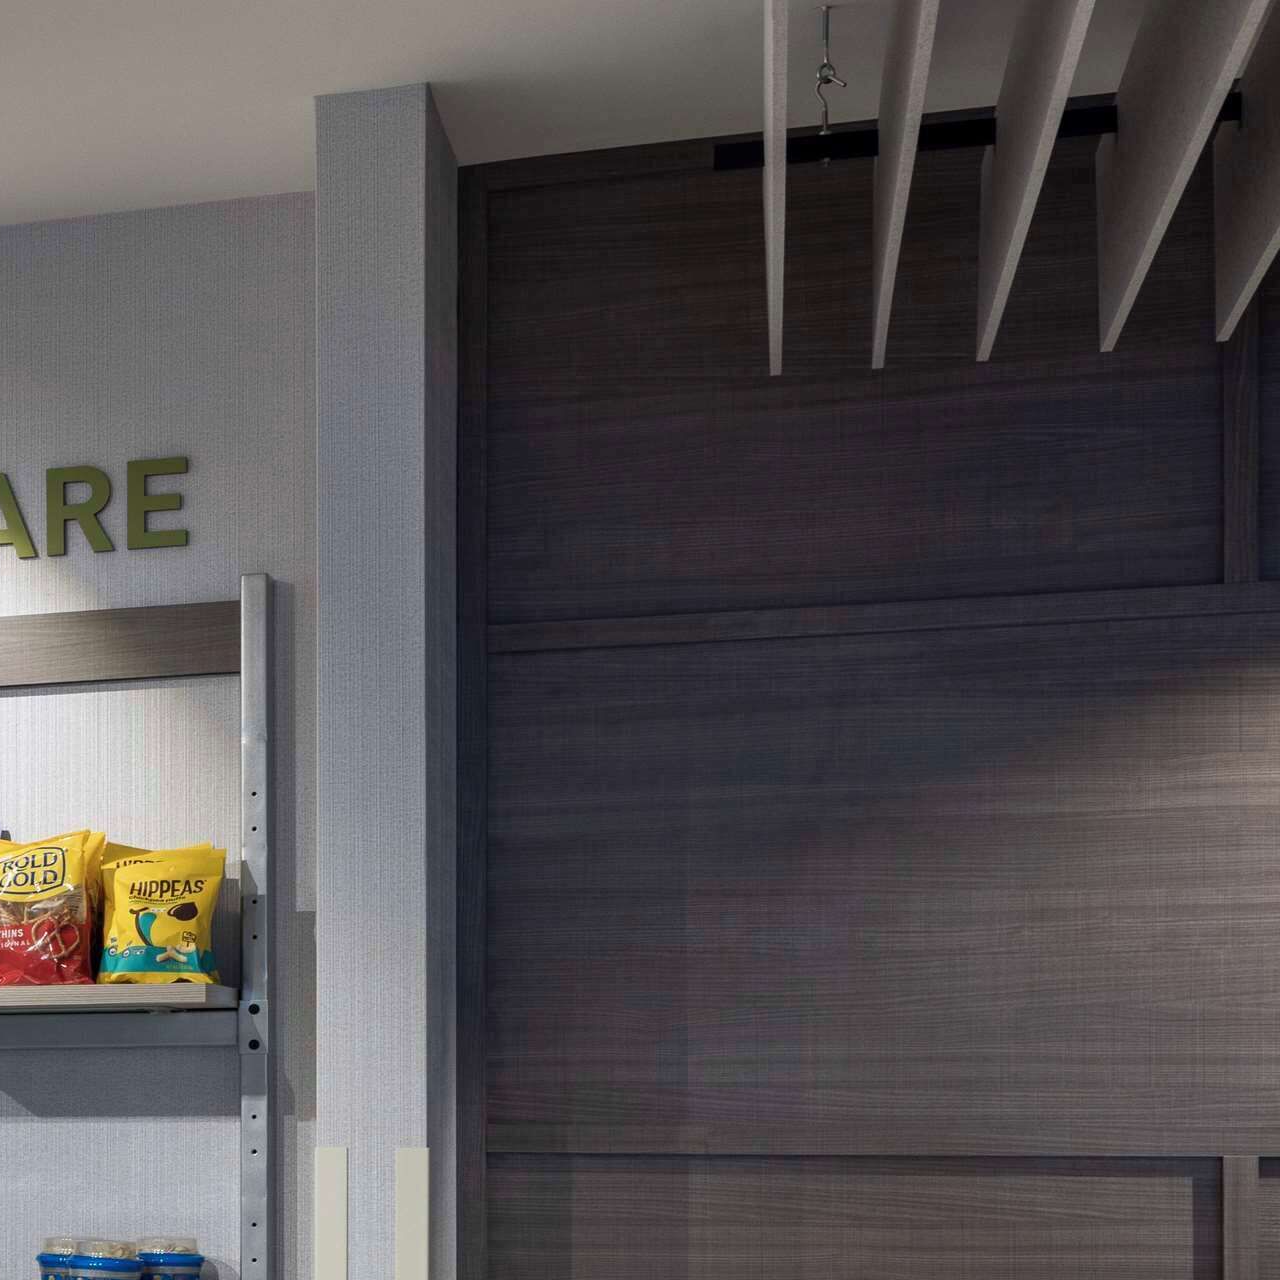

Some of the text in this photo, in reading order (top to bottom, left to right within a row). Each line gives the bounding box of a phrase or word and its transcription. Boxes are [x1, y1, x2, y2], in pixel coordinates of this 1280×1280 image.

[2, 852, 58, 874] ROLD
[0, 869, 58, 888] GOLD
[129, 879, 206, 898] HIPPEAS
